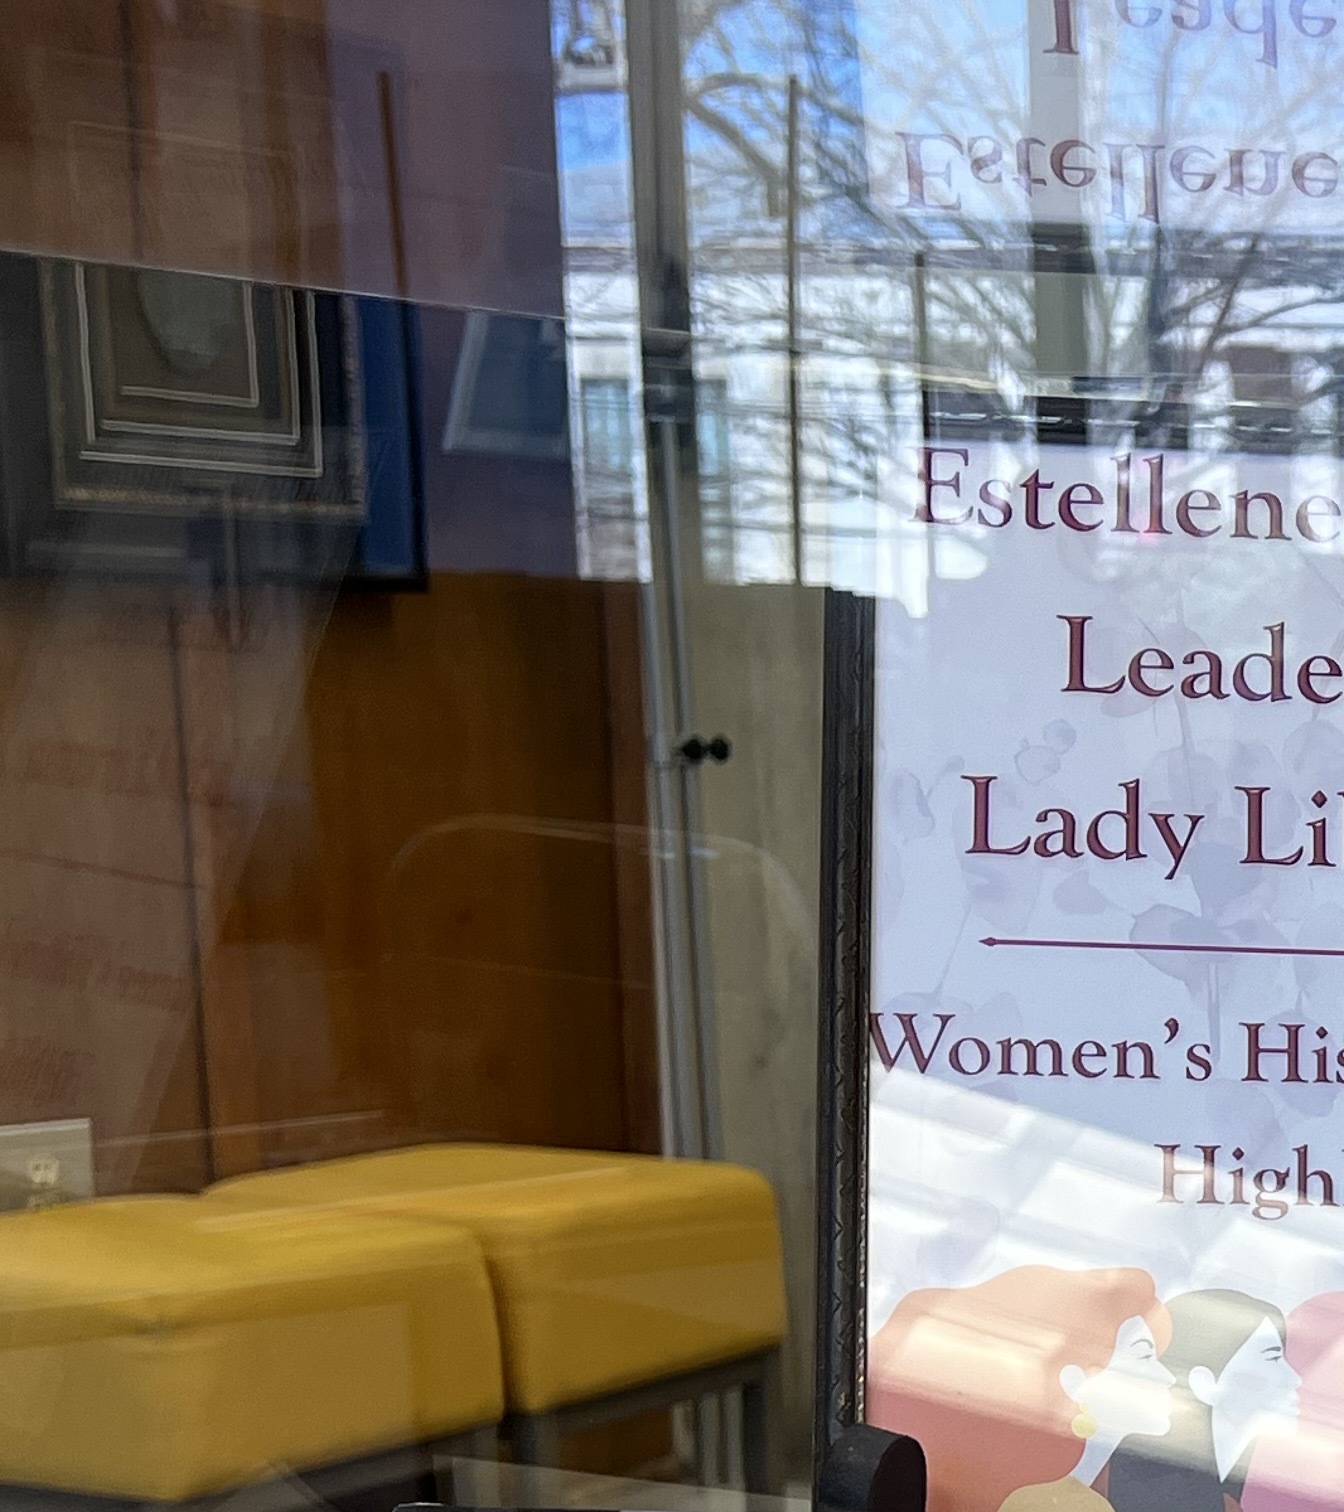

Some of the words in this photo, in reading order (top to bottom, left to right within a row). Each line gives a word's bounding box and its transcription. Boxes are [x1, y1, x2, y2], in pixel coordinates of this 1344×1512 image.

[912, 445, 1343, 546] Estellene
[961, 774, 1204, 880] Lady
[869, 1010, 1214, 1084] Women’s
